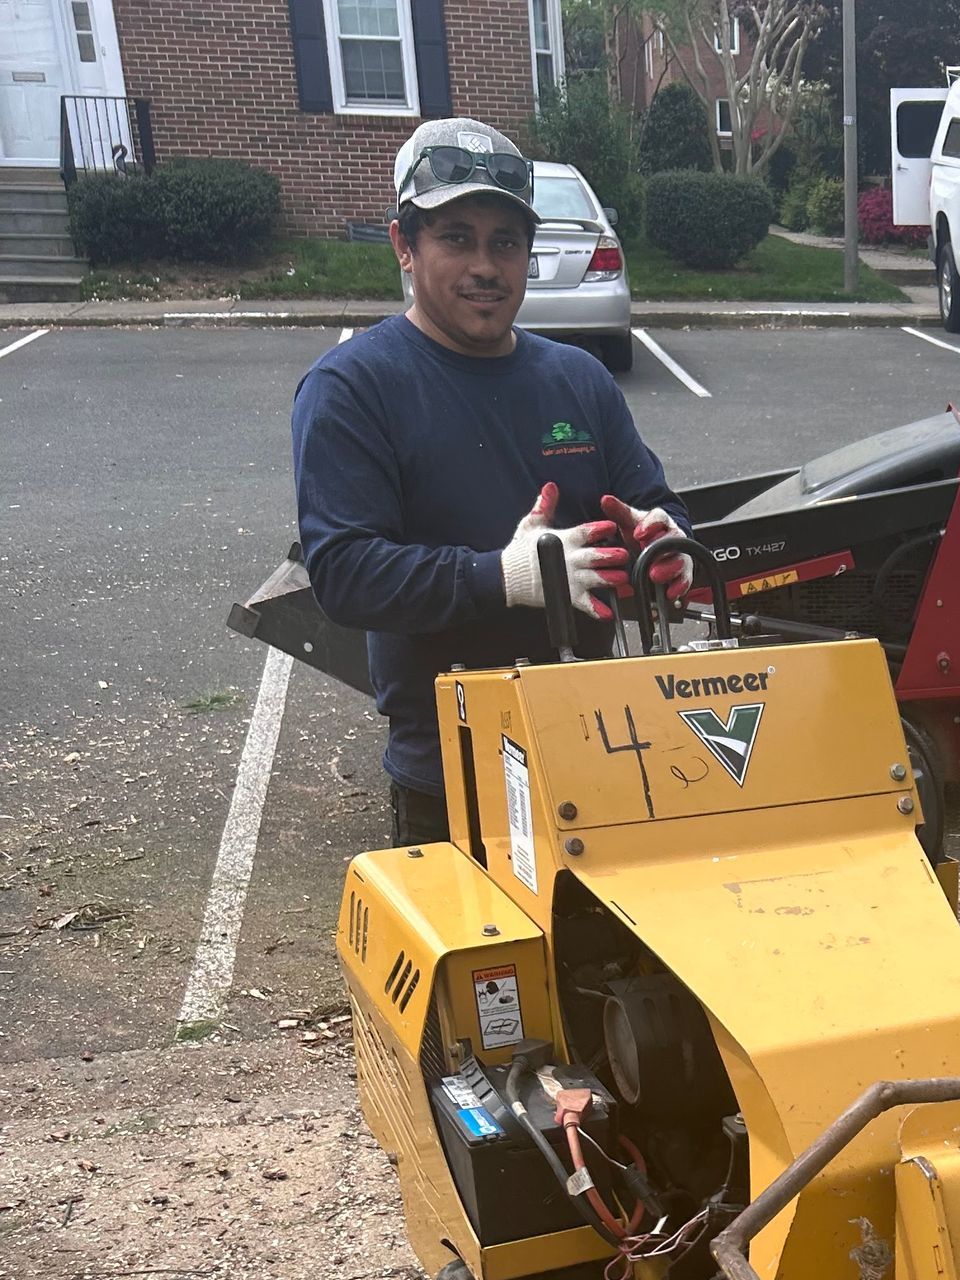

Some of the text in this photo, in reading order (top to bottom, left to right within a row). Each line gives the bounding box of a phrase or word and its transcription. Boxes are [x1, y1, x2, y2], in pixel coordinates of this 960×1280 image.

[710, 546, 741, 562] GO
[654, 671, 769, 700] Vermeer
[594, 704, 655, 819] 4
